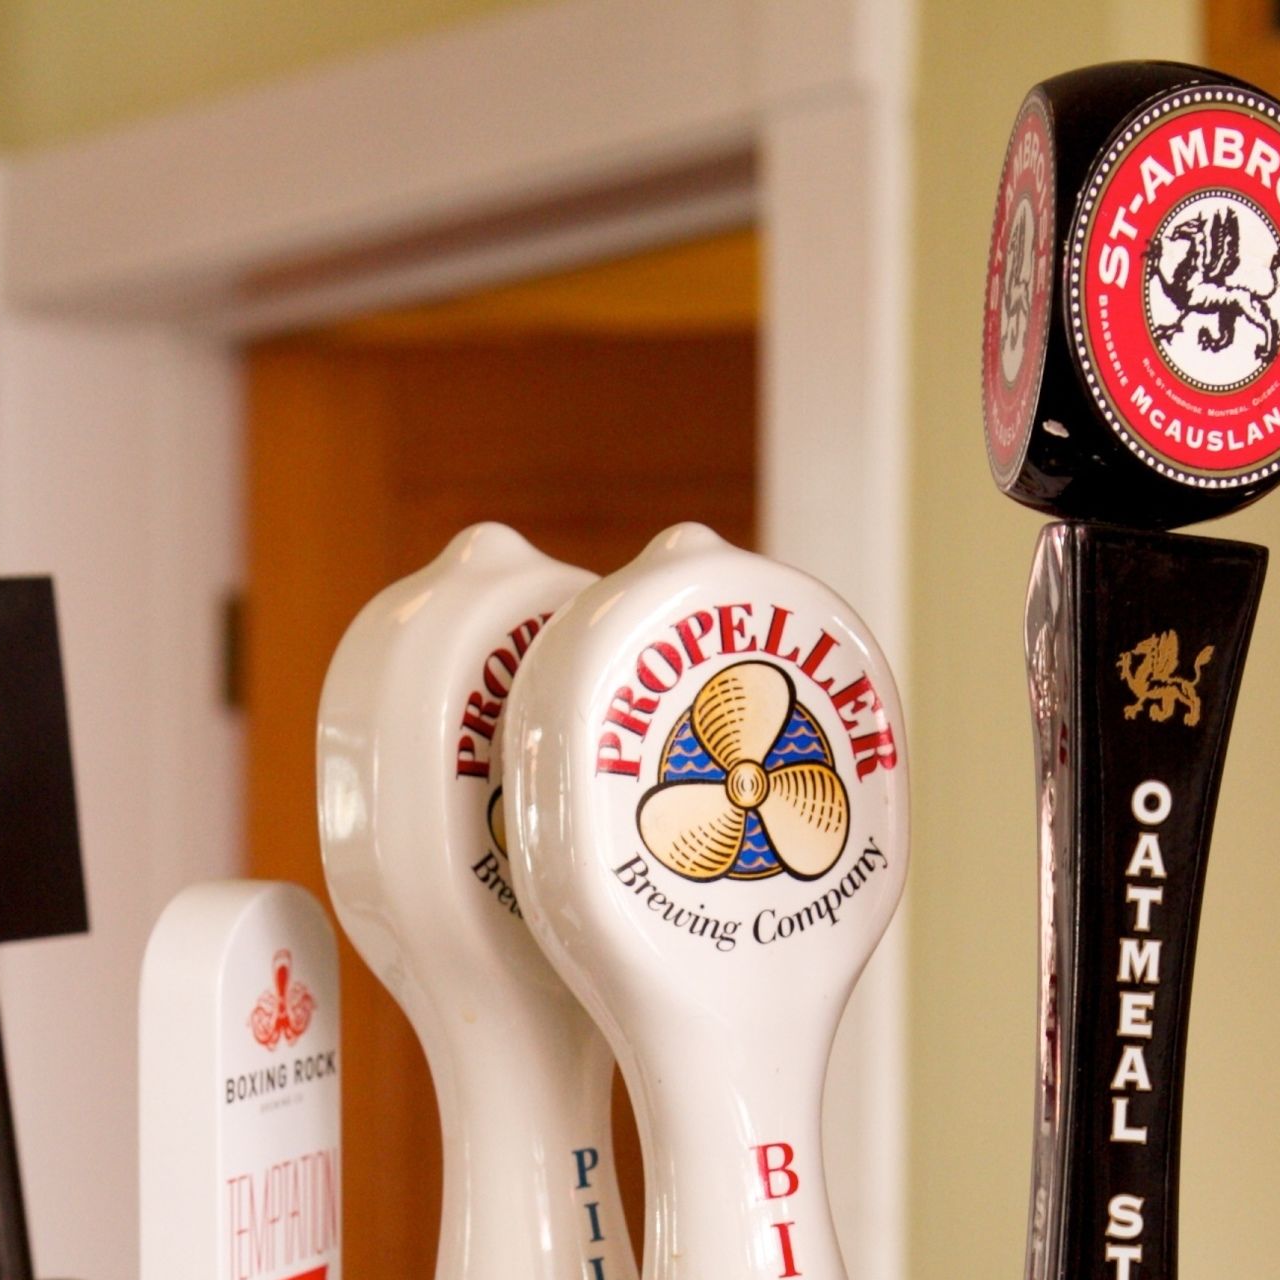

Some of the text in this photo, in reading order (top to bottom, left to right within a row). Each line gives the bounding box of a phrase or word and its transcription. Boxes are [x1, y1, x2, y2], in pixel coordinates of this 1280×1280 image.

[1098, 294, 1129, 388] BRASSERIE
[456, 610, 555, 784] PROP
[595, 602, 899, 783] PROPELLER
[613, 836, 889, 953] Brewing Company
[1109, 779, 1173, 1145] OATMEAL
[225, 1062, 288, 1105] BOXING
[292, 1049, 336, 1086] ROCK
